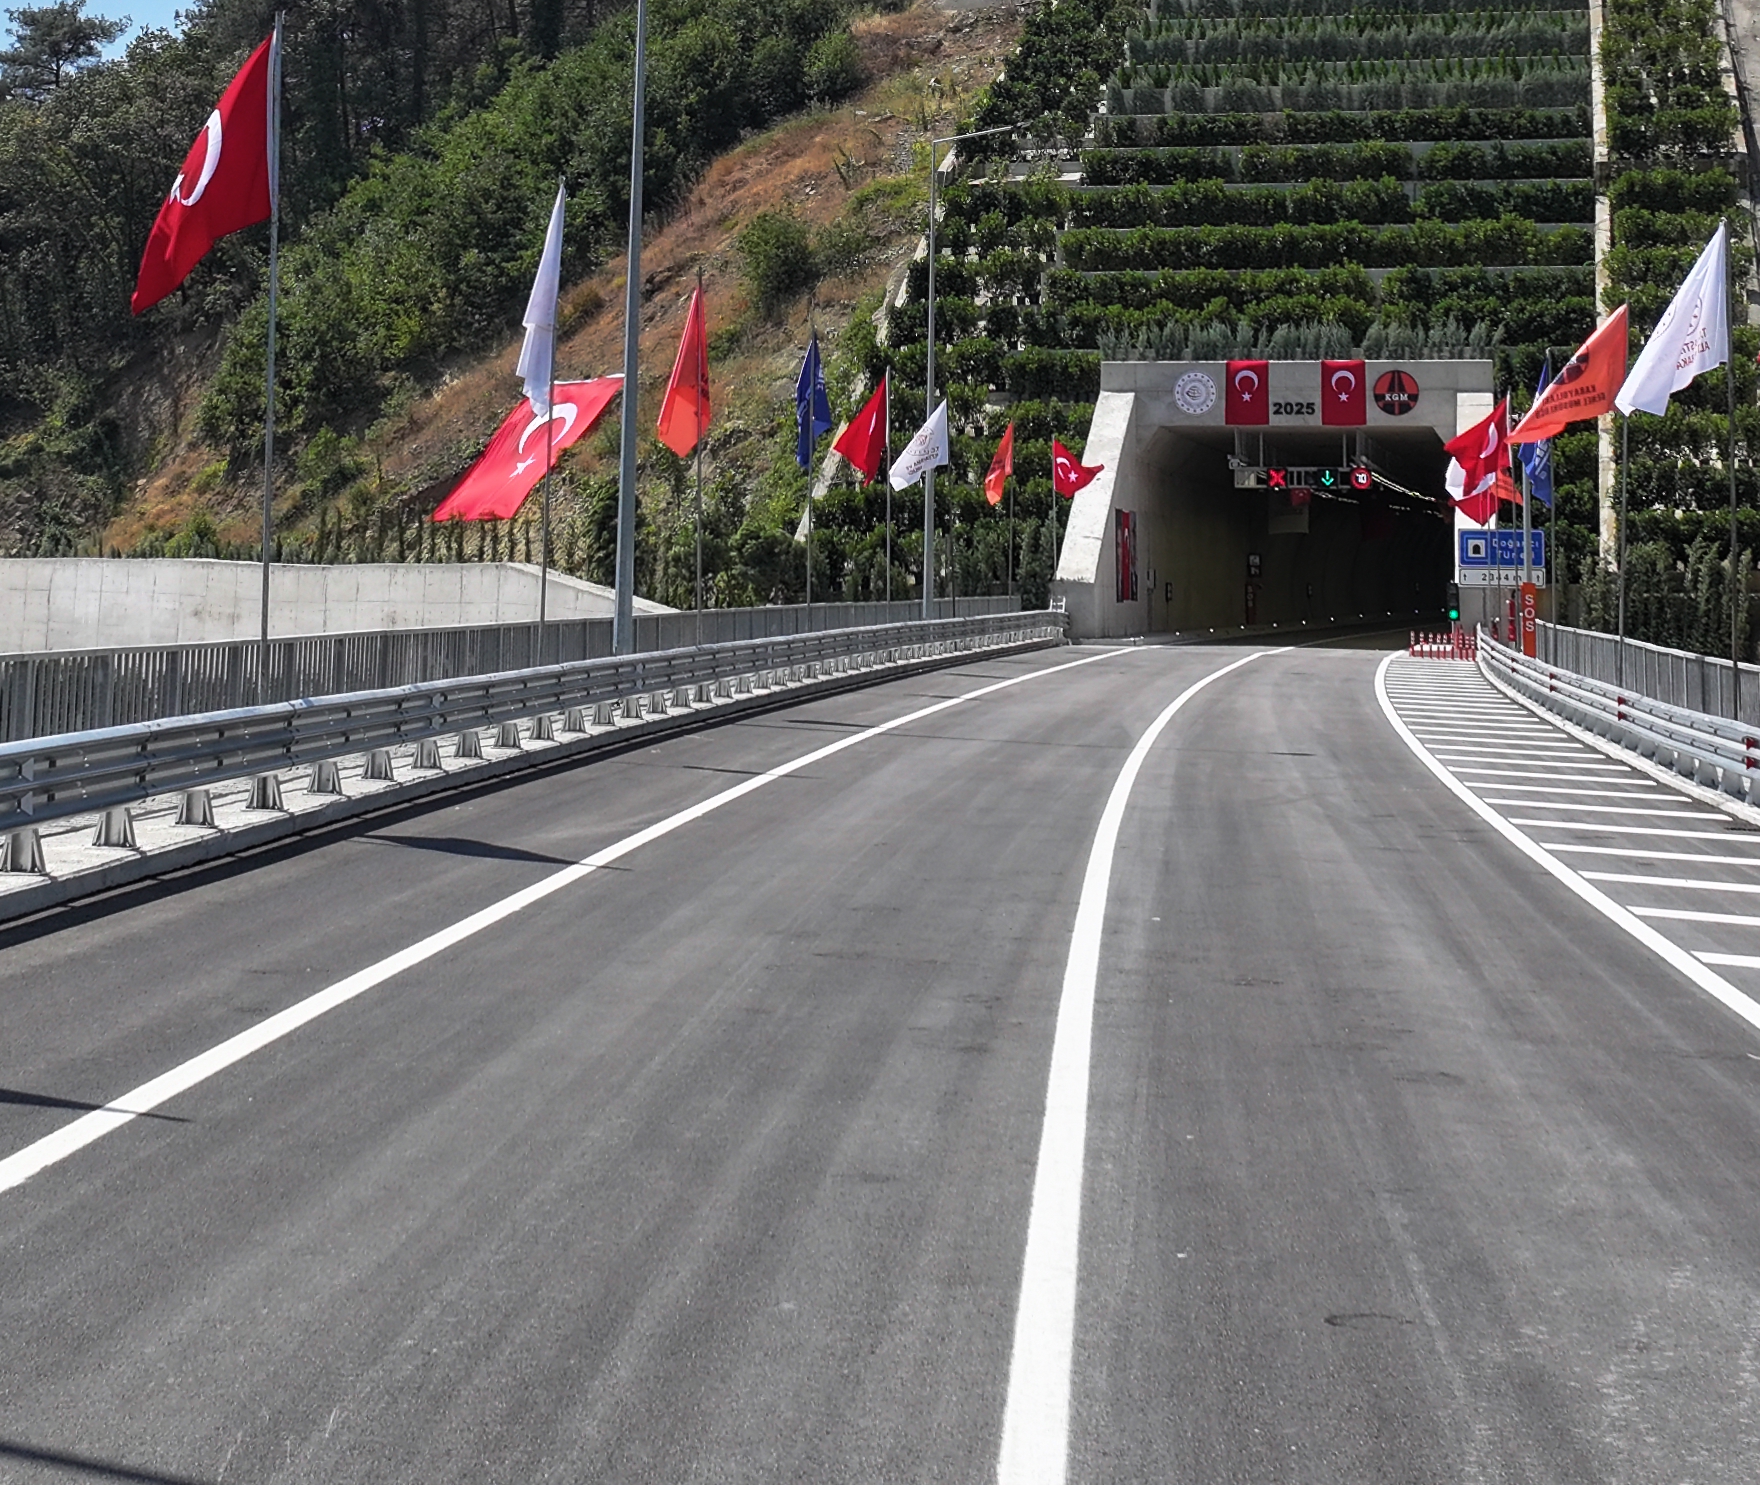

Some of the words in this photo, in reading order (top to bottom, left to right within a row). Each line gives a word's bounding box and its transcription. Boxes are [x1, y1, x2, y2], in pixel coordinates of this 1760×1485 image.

[1384, 392, 1409, 402] KGM
[1273, 402, 1316, 416] 2025
[1524, 594, 1535, 632] SOS
